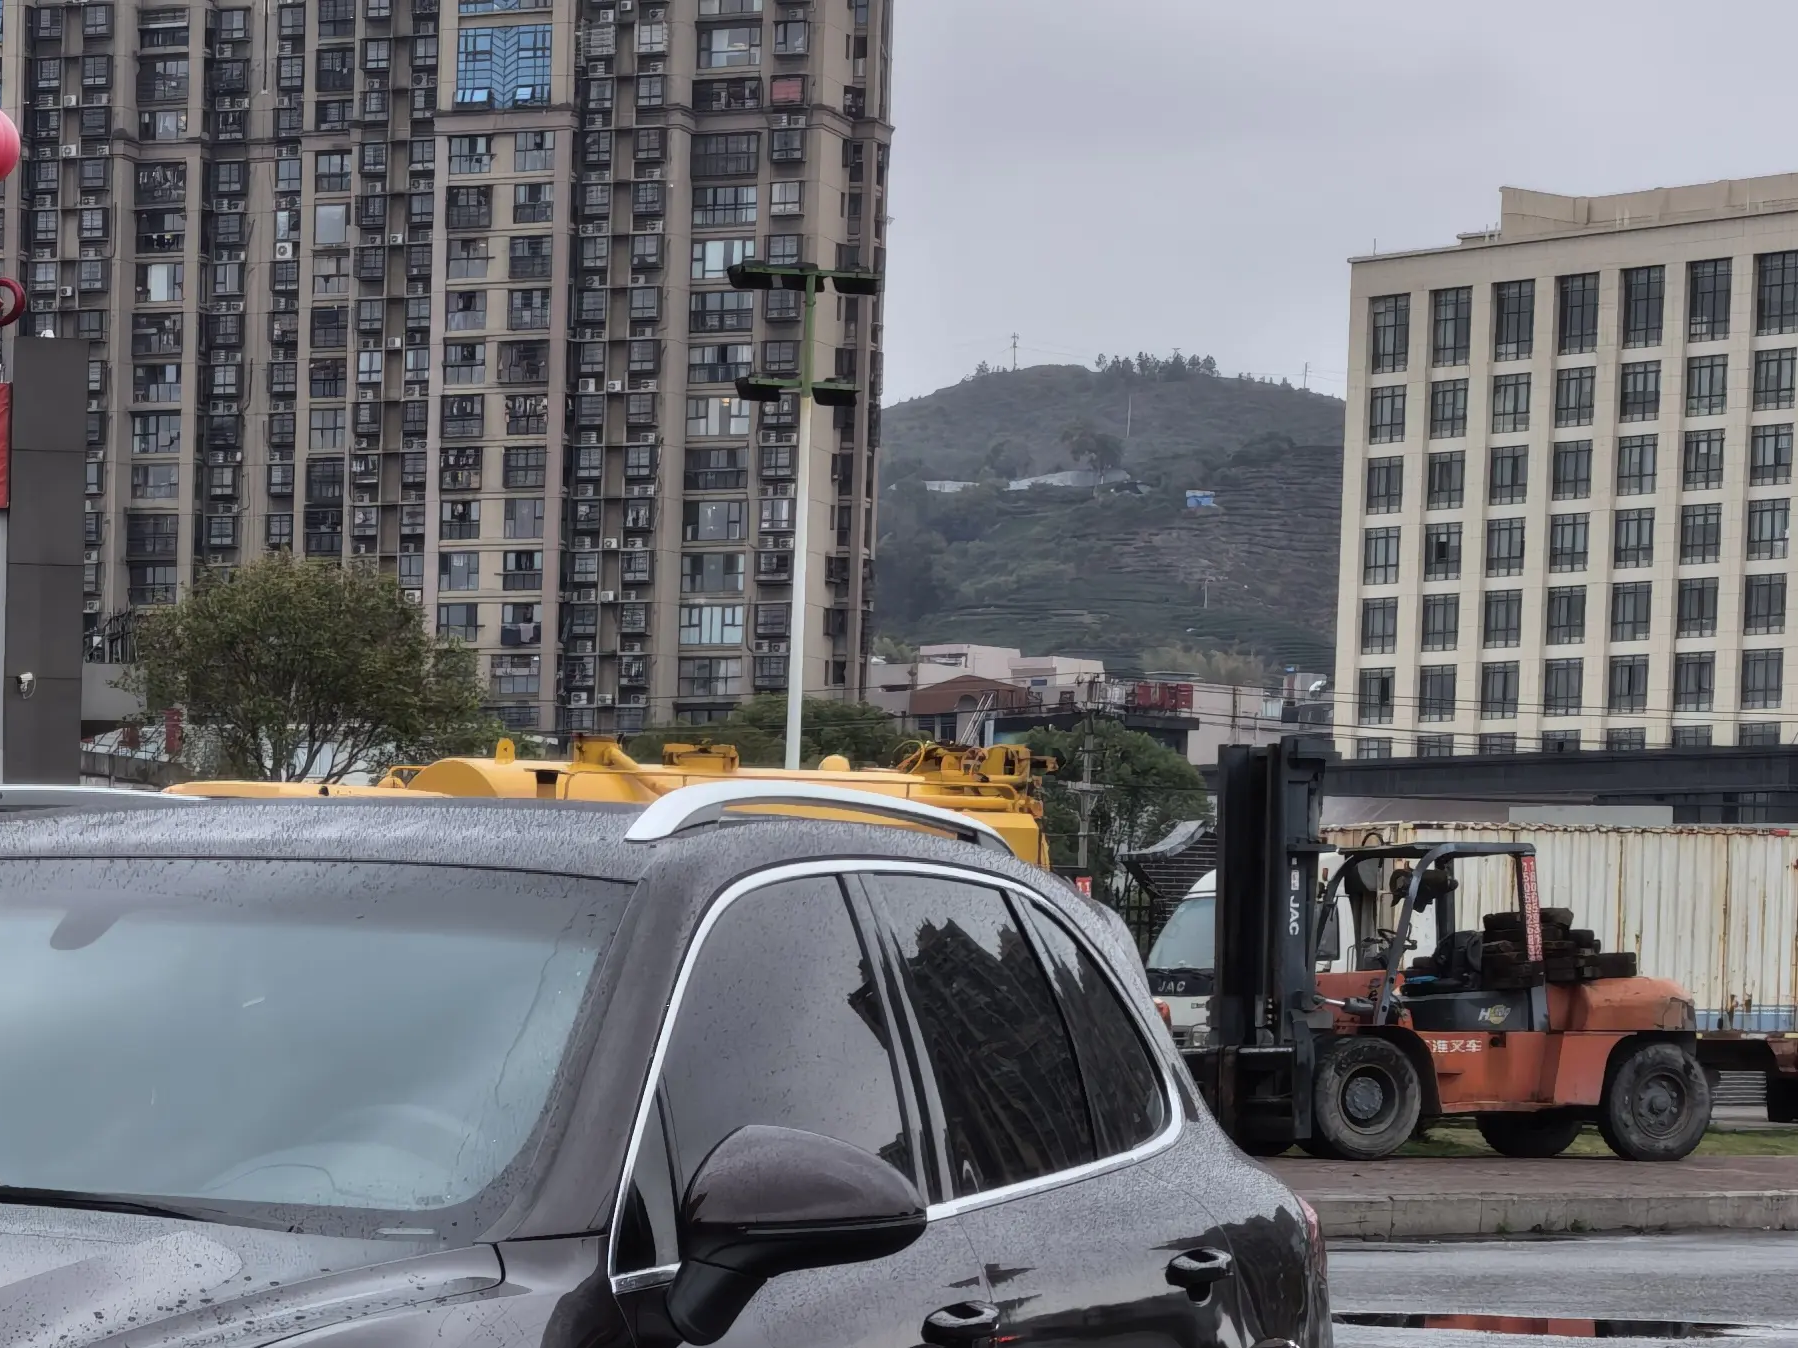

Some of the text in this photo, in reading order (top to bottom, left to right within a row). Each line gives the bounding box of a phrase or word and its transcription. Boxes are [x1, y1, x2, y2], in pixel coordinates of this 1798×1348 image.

[1289, 895, 1300, 936] JAC
[1157, 980, 1186, 993] JAC
[1426, 1039, 1482, 1053] 淮叉车
